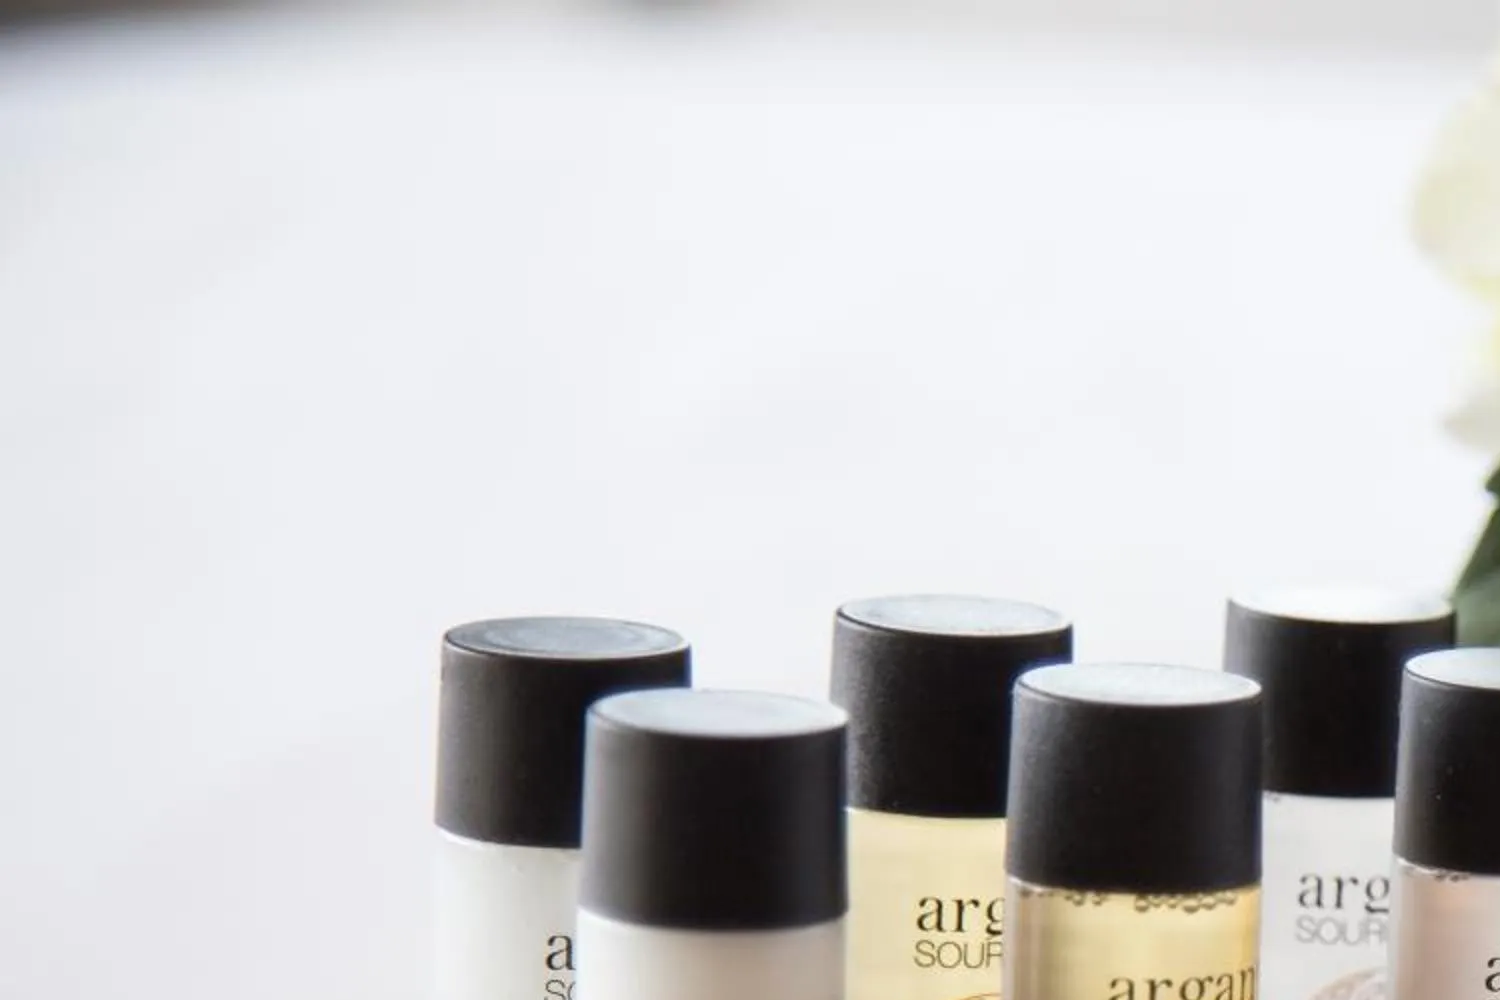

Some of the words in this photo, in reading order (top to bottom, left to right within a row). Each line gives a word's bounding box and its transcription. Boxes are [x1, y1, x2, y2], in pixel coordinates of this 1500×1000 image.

[1298, 873, 1390, 914] arg
[916, 896, 1004, 936] arg
[1295, 914, 1388, 945] SOUR
